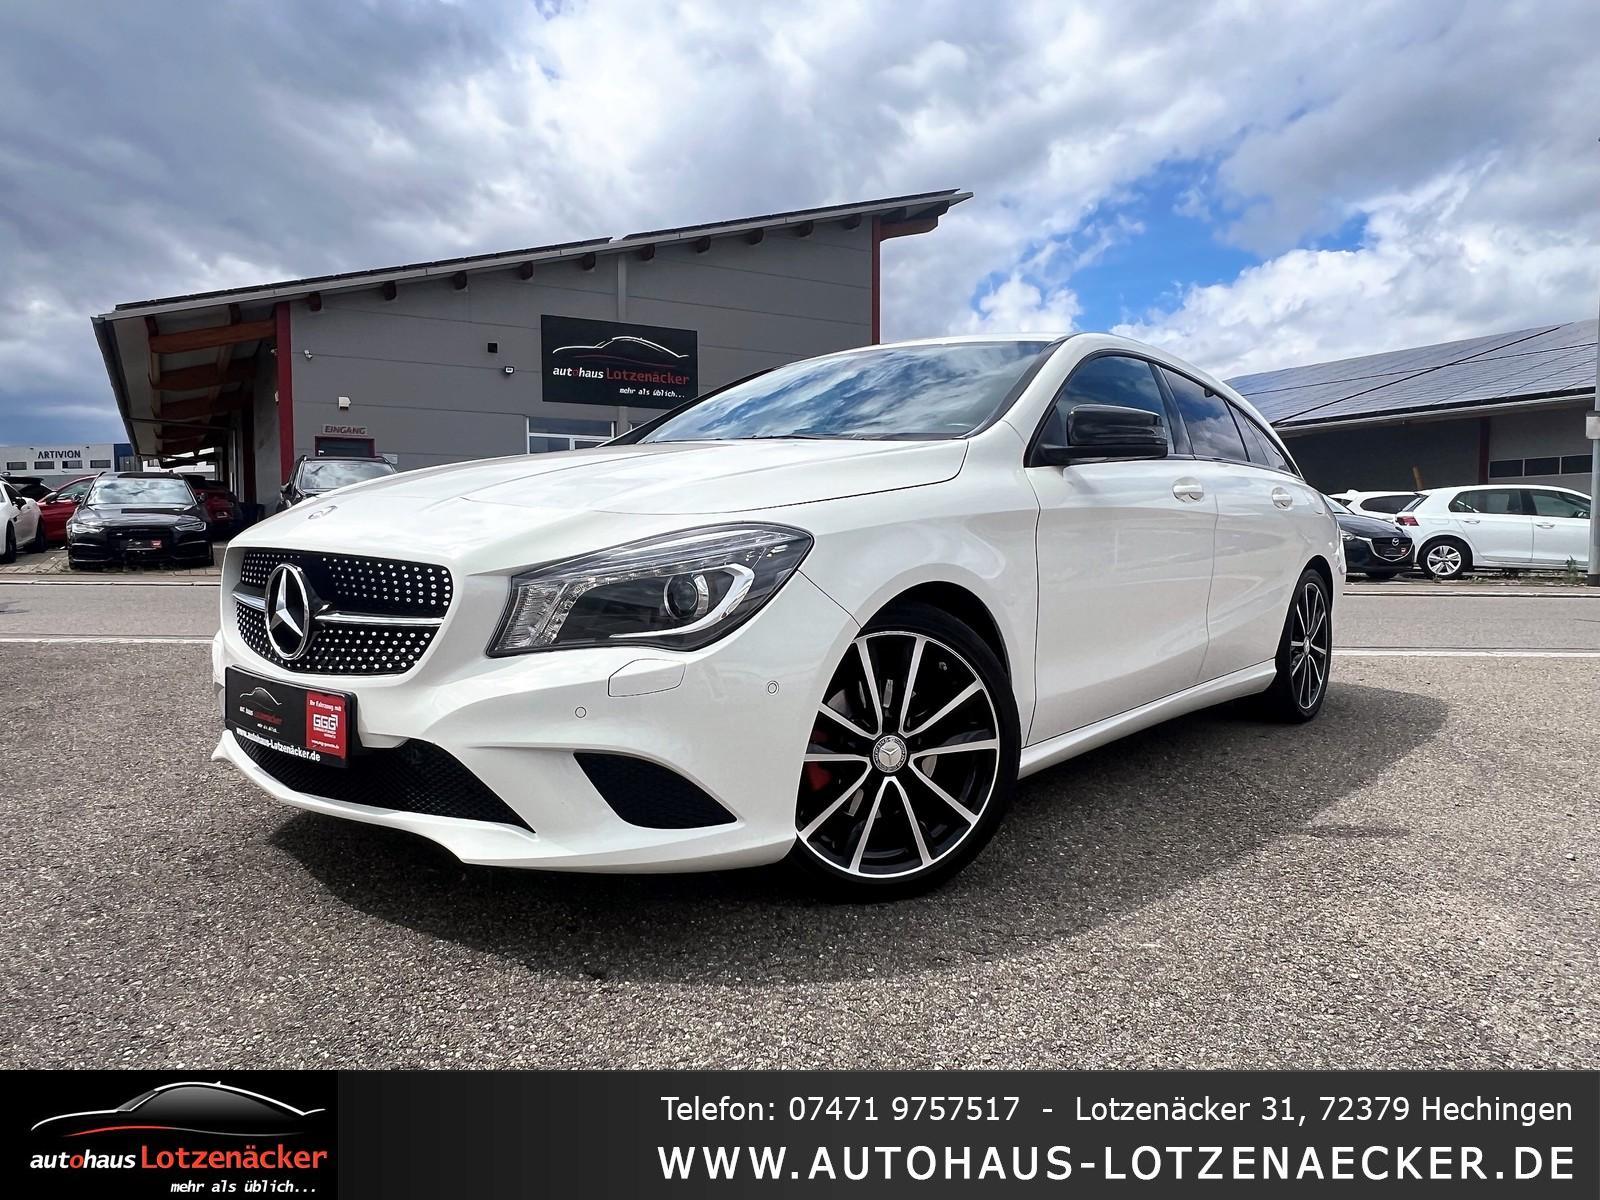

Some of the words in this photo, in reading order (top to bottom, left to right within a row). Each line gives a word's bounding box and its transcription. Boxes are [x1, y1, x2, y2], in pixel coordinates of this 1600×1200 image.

[552, 366, 604, 379] autohaus
[606, 367, 689, 385] Lotzenäcker
[325, 425, 367, 434] EINGANG
[37, 450, 81, 459] ARTIVION
